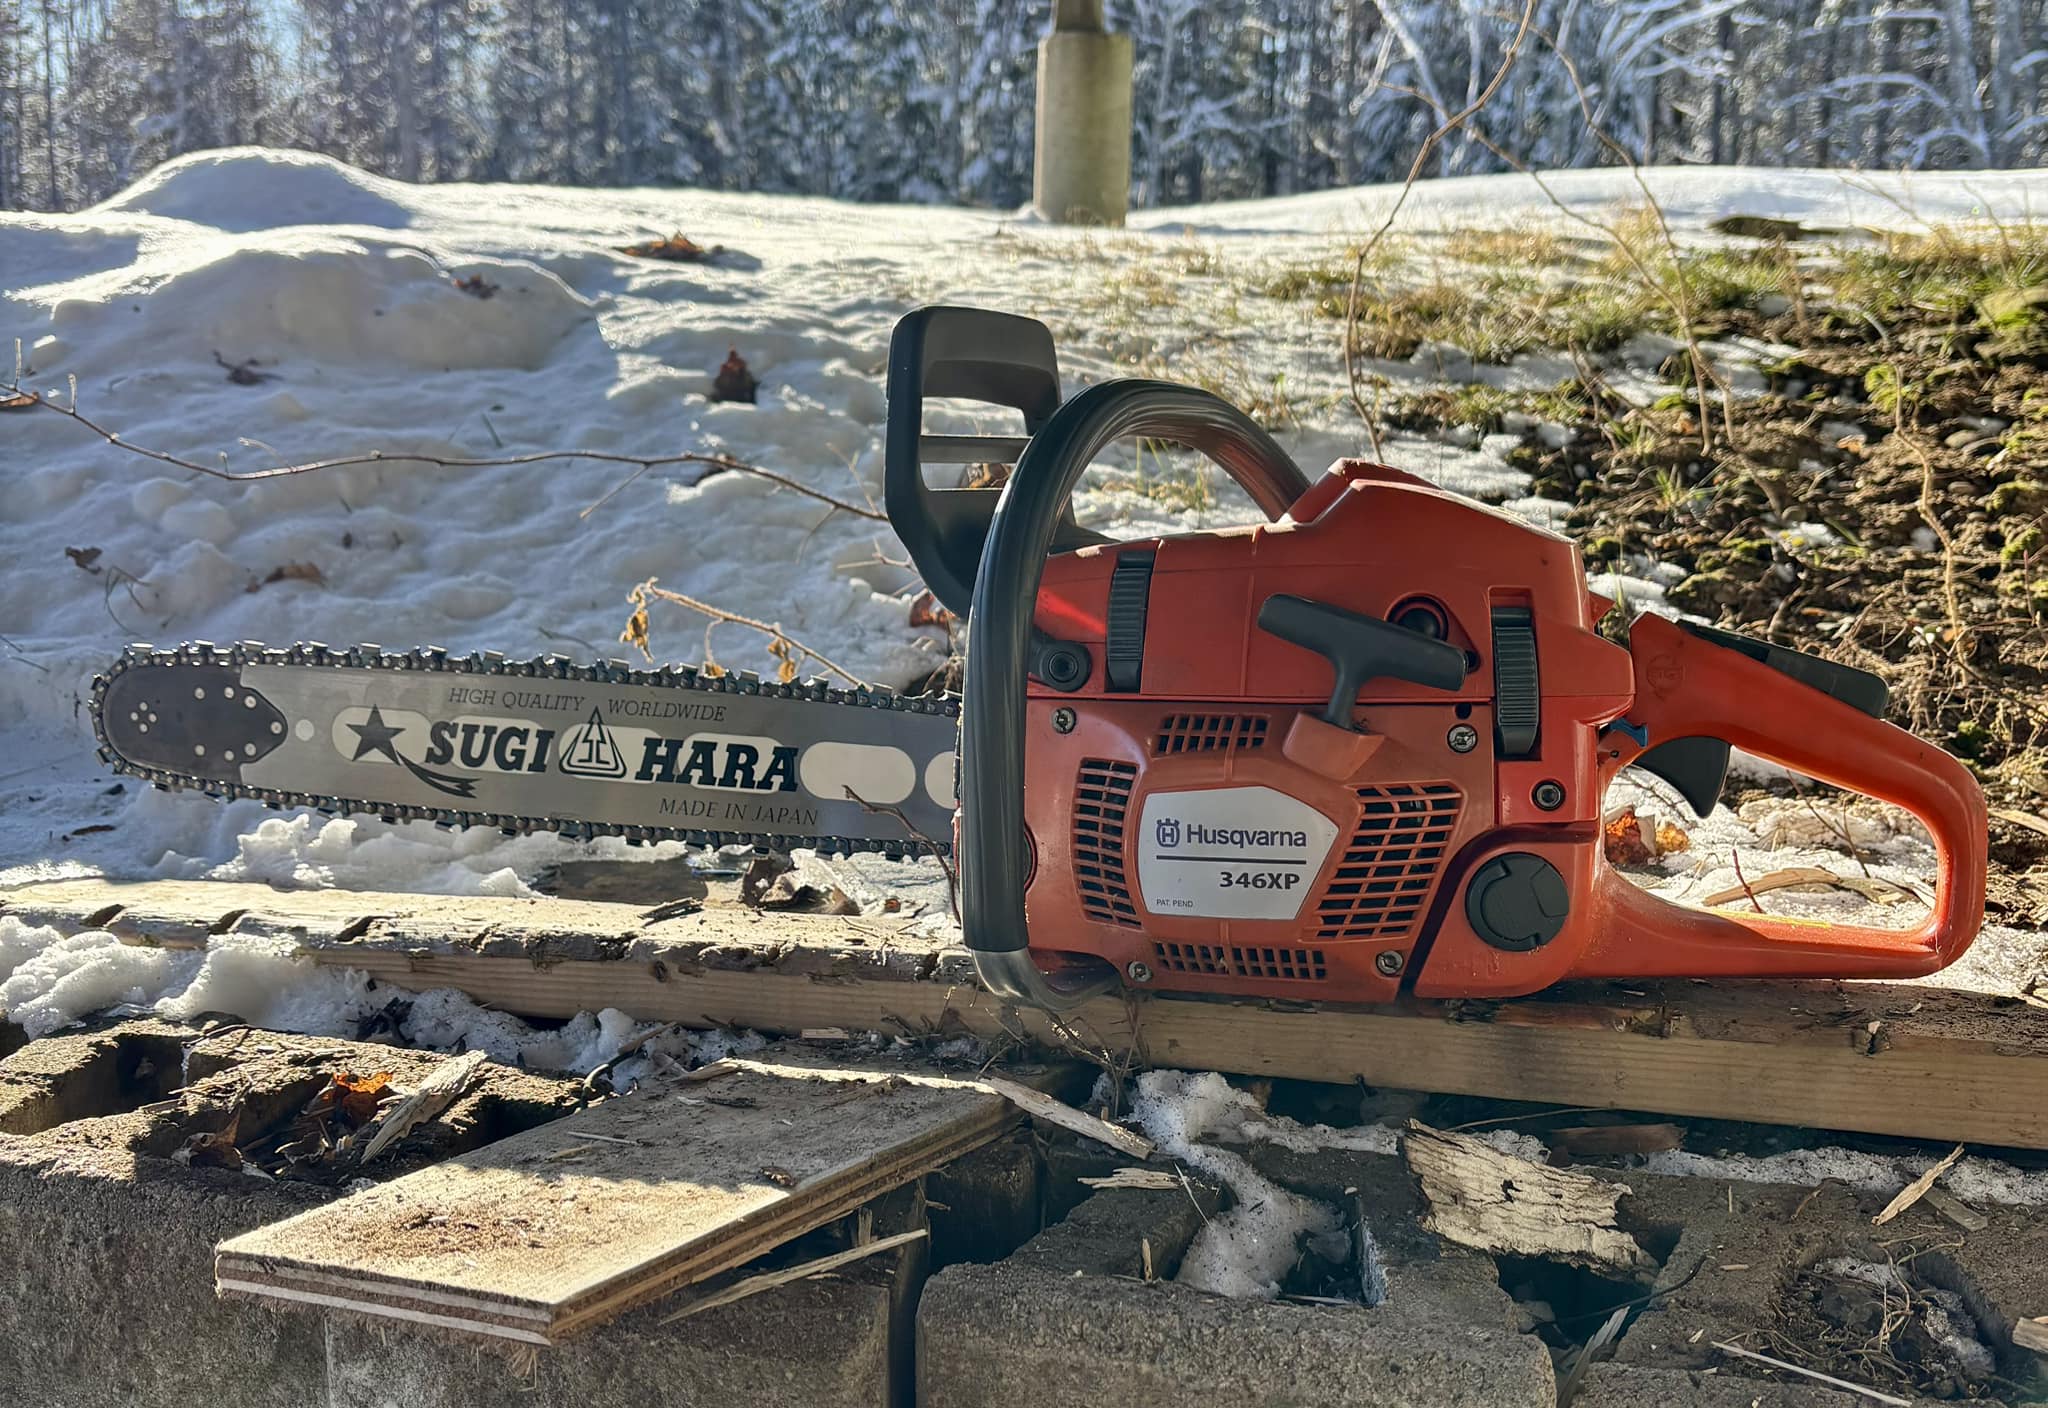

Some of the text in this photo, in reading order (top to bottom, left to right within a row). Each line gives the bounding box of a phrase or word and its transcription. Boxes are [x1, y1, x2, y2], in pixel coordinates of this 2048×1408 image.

[449, 687, 586, 711] HIGH QUALITY
[608, 699, 728, 722] WORLDWIDE
[426, 720, 799, 792] SUGI HARA
[659, 798, 818, 825] MADE IN JAPAN
[1186, 824, 1307, 848] Husqvarna
[1219, 871, 1300, 890] 346XP
[1172, 899, 1194, 908] PEND
